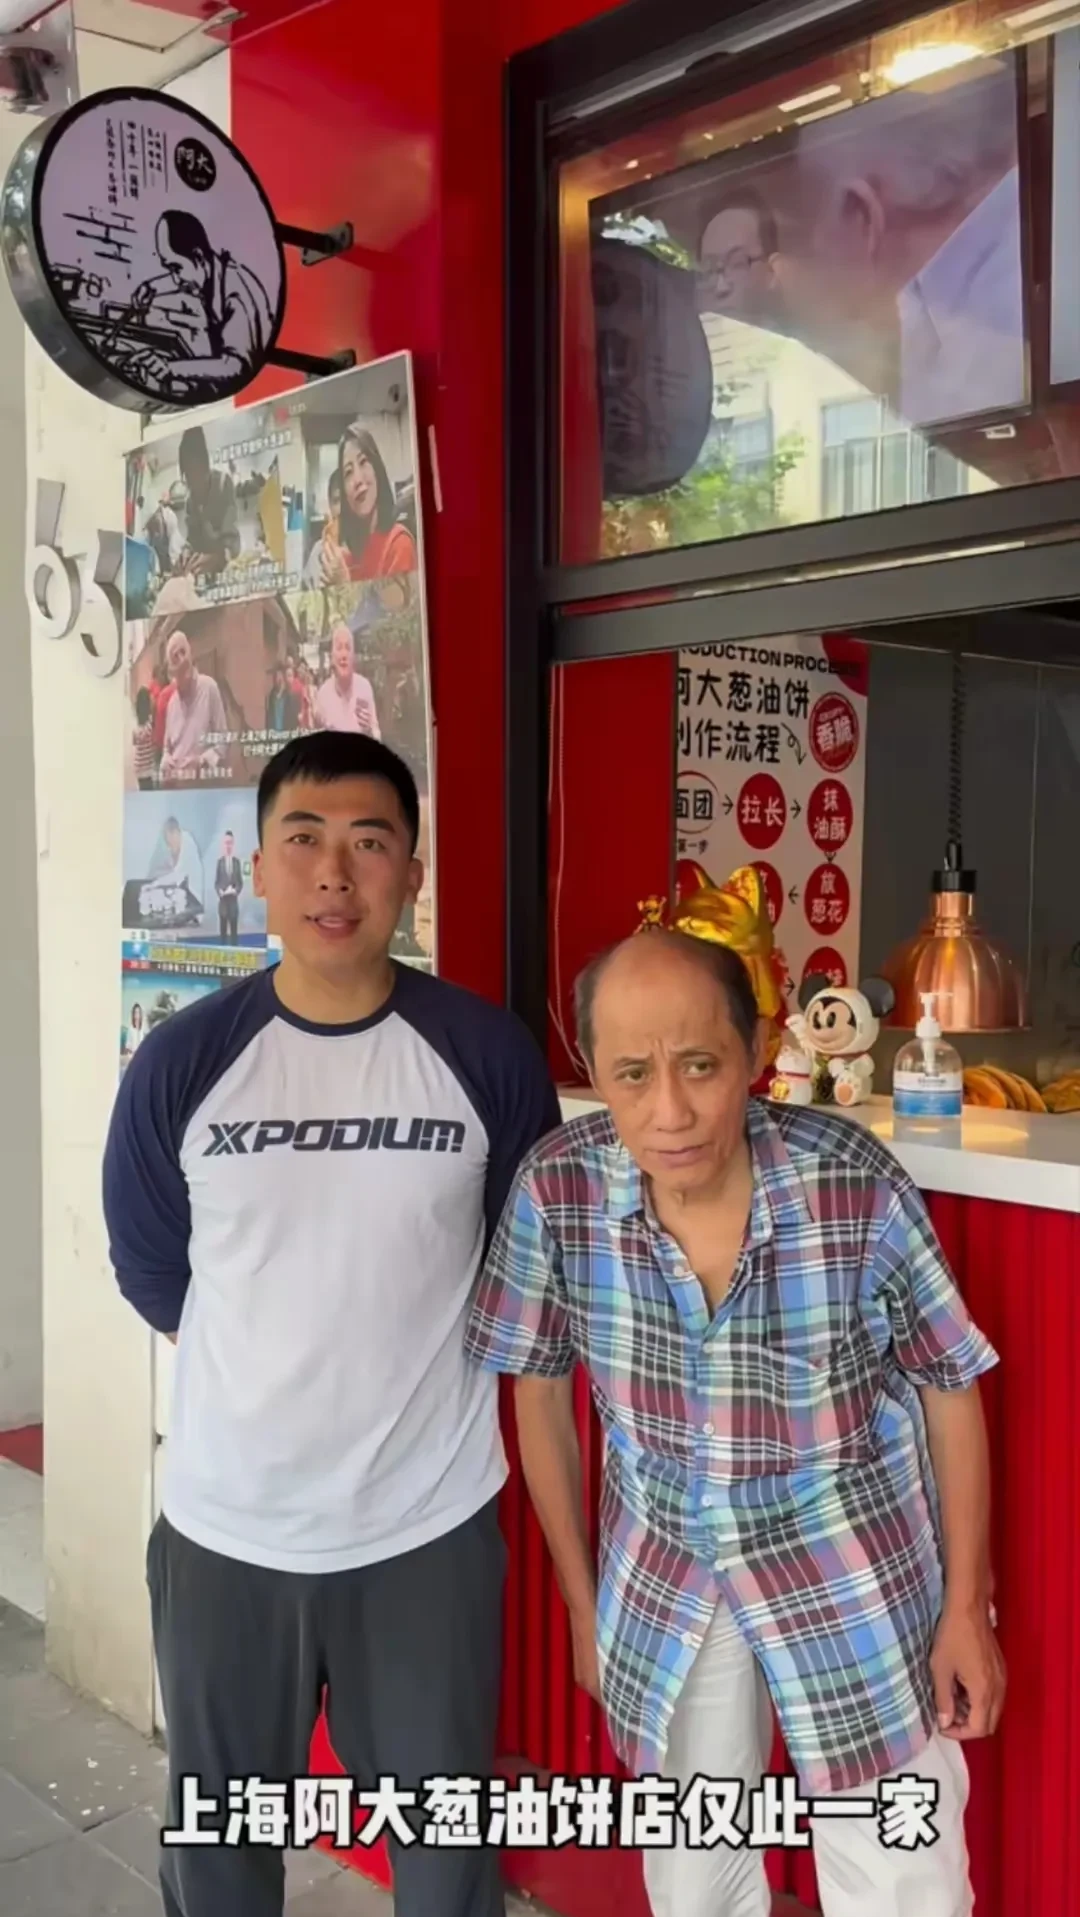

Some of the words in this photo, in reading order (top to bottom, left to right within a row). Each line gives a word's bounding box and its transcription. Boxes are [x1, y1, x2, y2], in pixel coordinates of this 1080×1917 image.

[177, 146, 213, 174] 阿大
[680, 643, 781, 667] ODUCTION
[816, 715, 853, 753] 香脆
[741, 795, 784, 828] 拉长
[811, 898, 843, 924] 葱花
